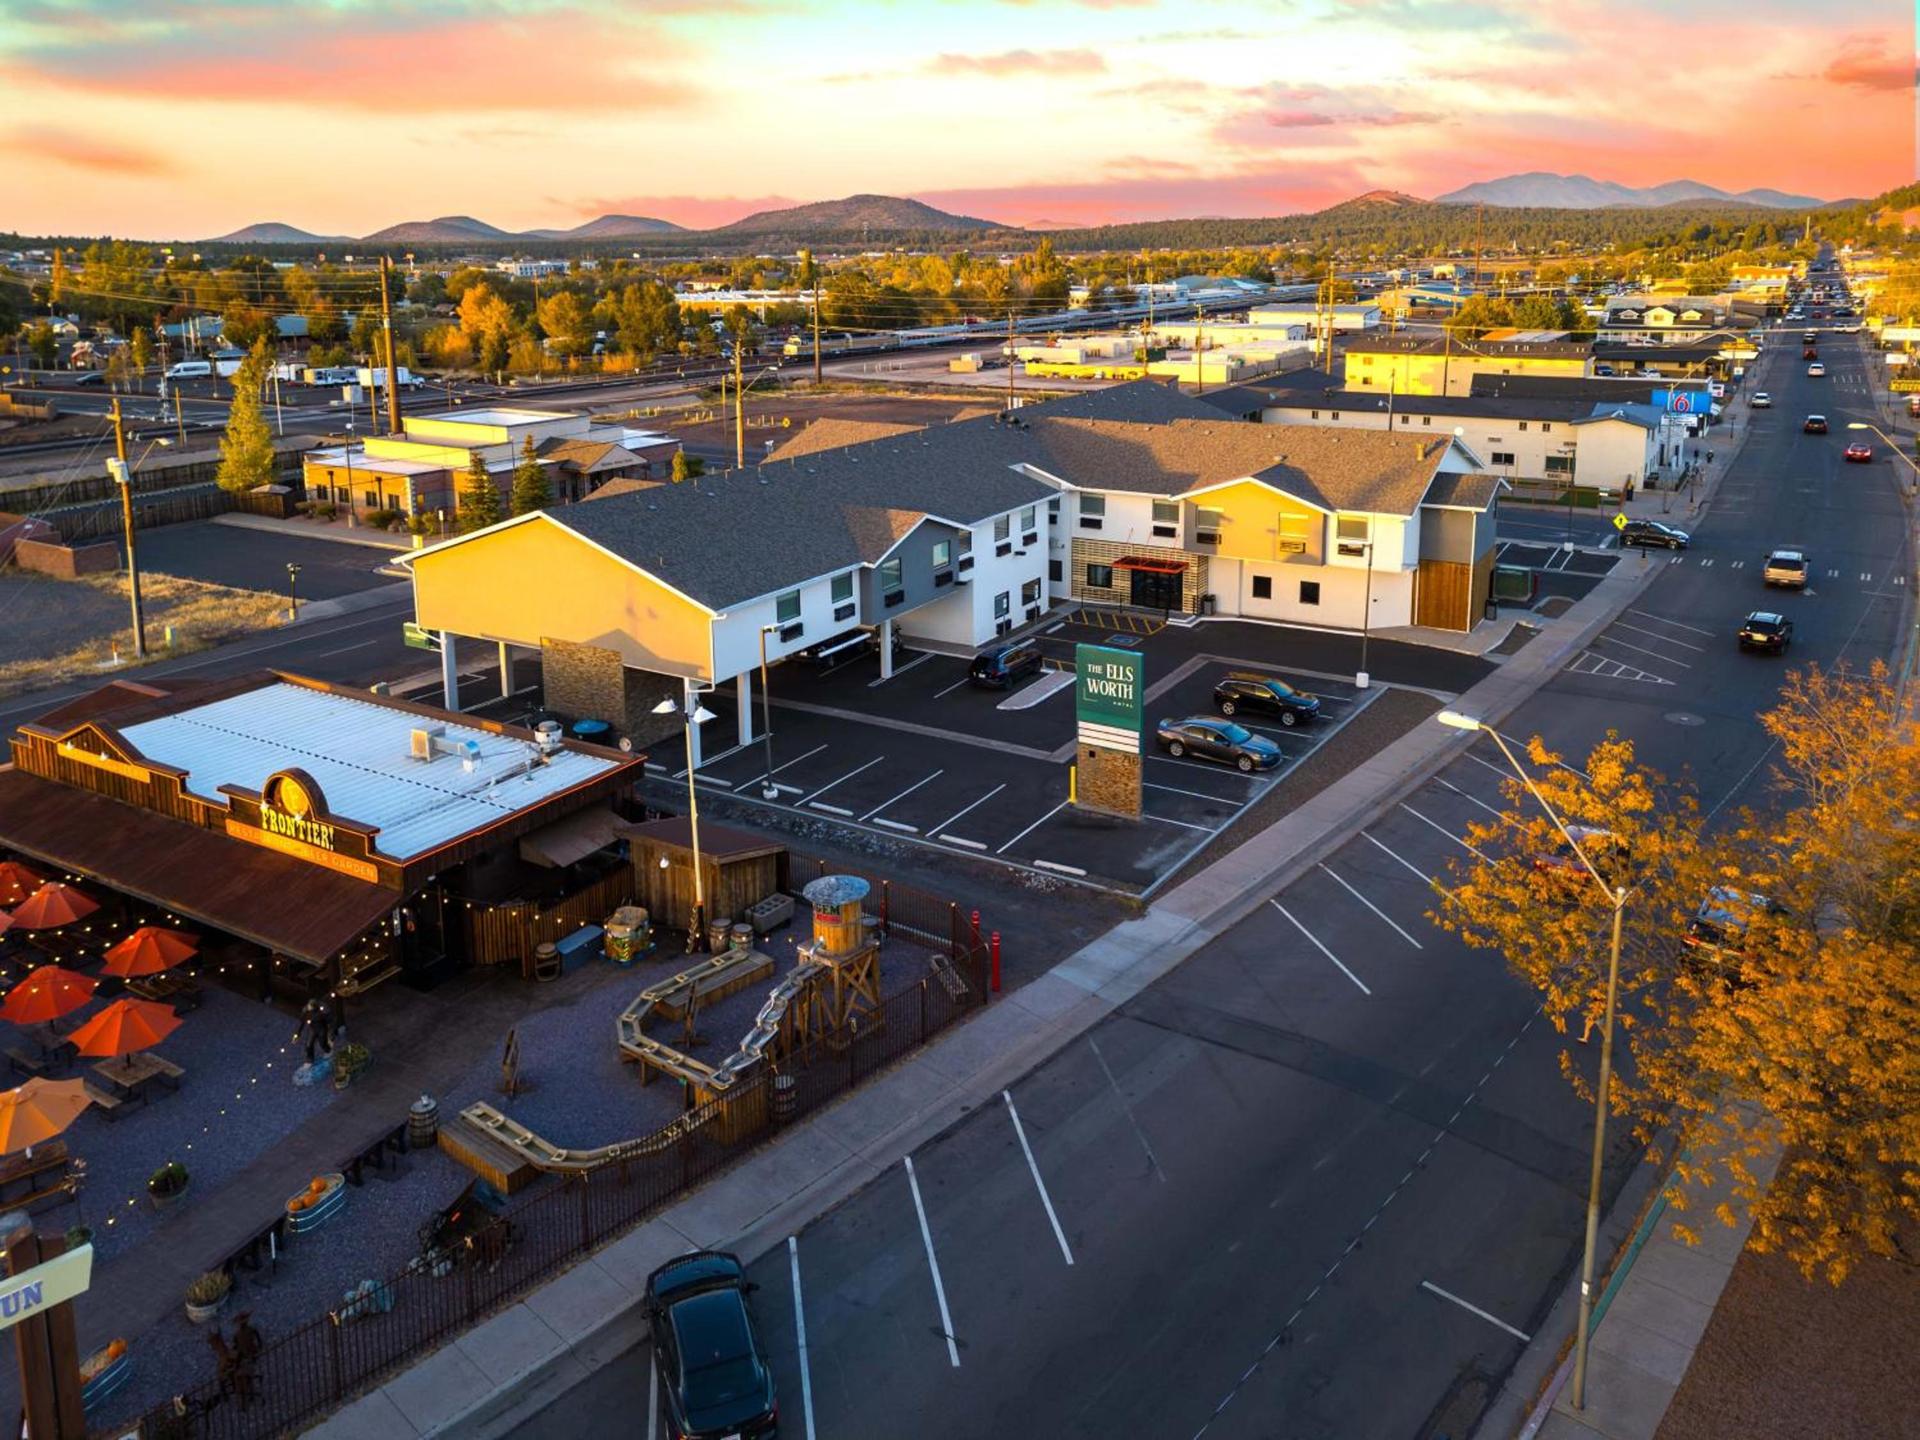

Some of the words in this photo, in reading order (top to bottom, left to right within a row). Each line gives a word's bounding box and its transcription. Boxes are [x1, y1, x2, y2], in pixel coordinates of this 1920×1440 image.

[1674, 393, 1690, 412] 6
[1088, 664, 1103, 674] THE
[1107, 663, 1134, 681] ELLS
[1088, 678, 1133, 698] WORTH
[261, 808, 335, 851] FRONTIER!
